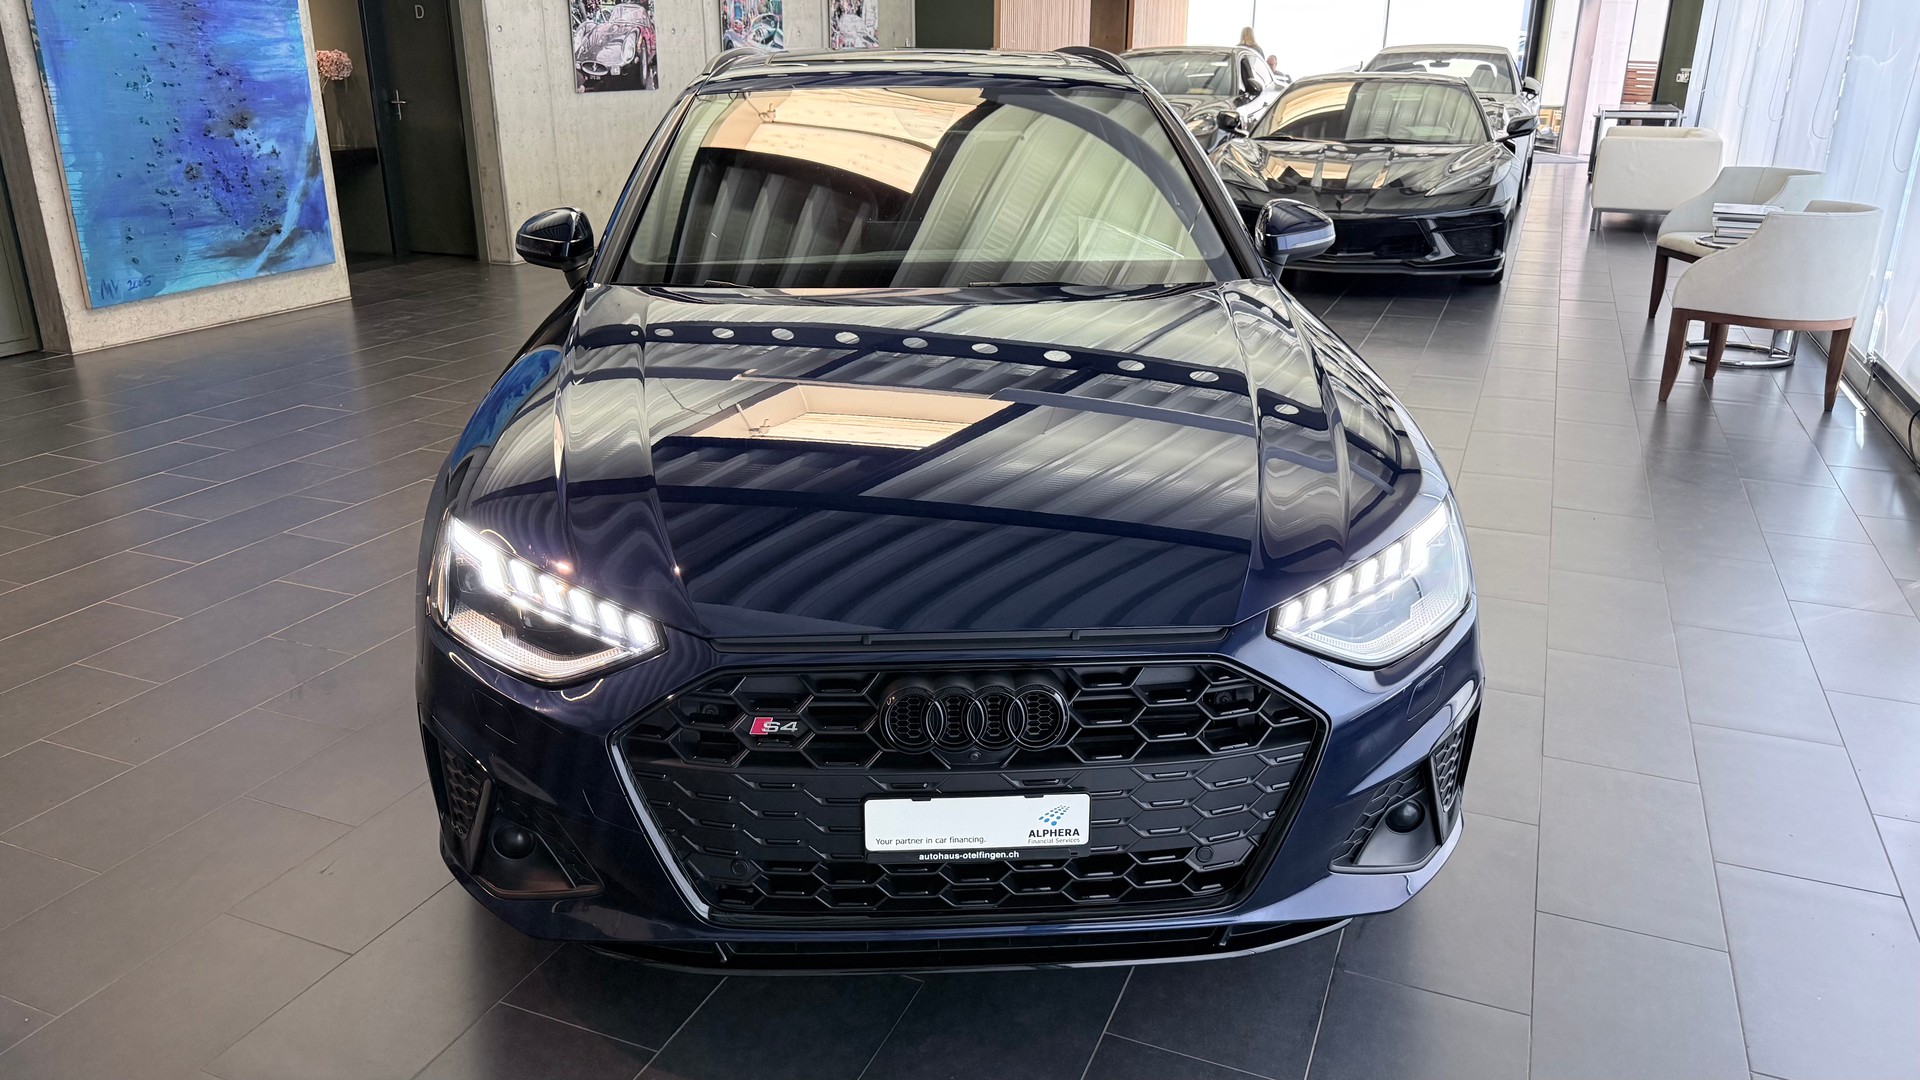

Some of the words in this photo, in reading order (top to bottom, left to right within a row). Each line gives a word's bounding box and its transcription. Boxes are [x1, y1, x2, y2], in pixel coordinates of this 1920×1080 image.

[415, 4, 425, 19] D
[762, 721, 798, 733] S4
[1028, 828, 1080, 838] ALPHERA
[895, 837, 923, 846] partner
[925, 836, 933, 844] in
[949, 836, 987, 845] financing.
[919, 850, 1020, 861] autohaus-otelfingen.ch
